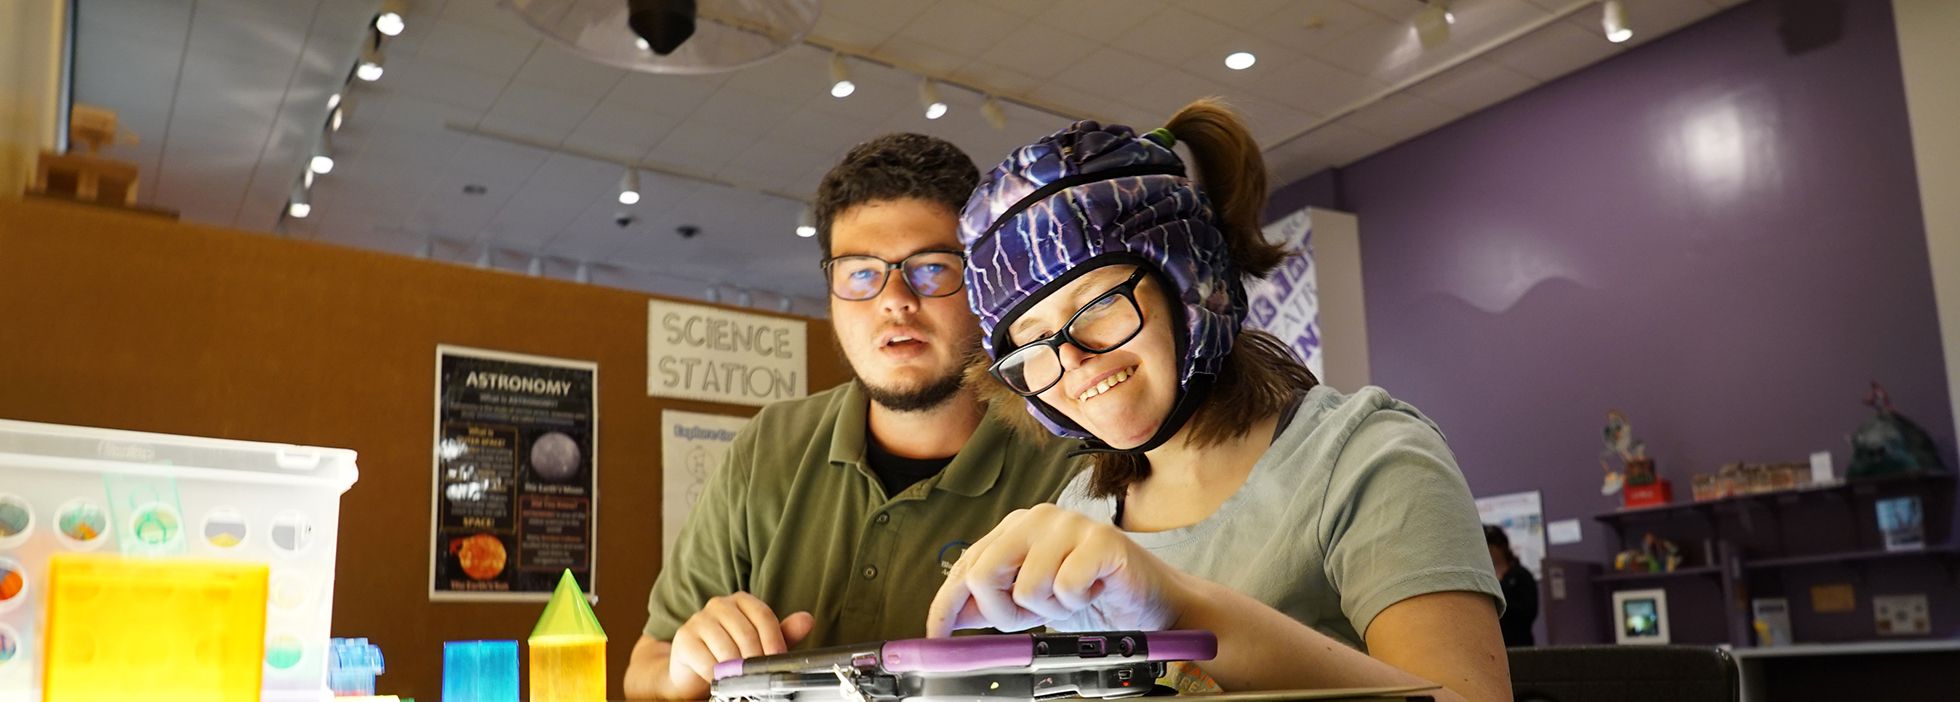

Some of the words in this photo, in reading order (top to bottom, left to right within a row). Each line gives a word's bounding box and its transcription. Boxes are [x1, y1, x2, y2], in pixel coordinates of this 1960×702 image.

[662, 312, 793, 359] SCIENCE
[465, 371, 572, 396] ASTRONOMY
[658, 355, 797, 399] STATION
